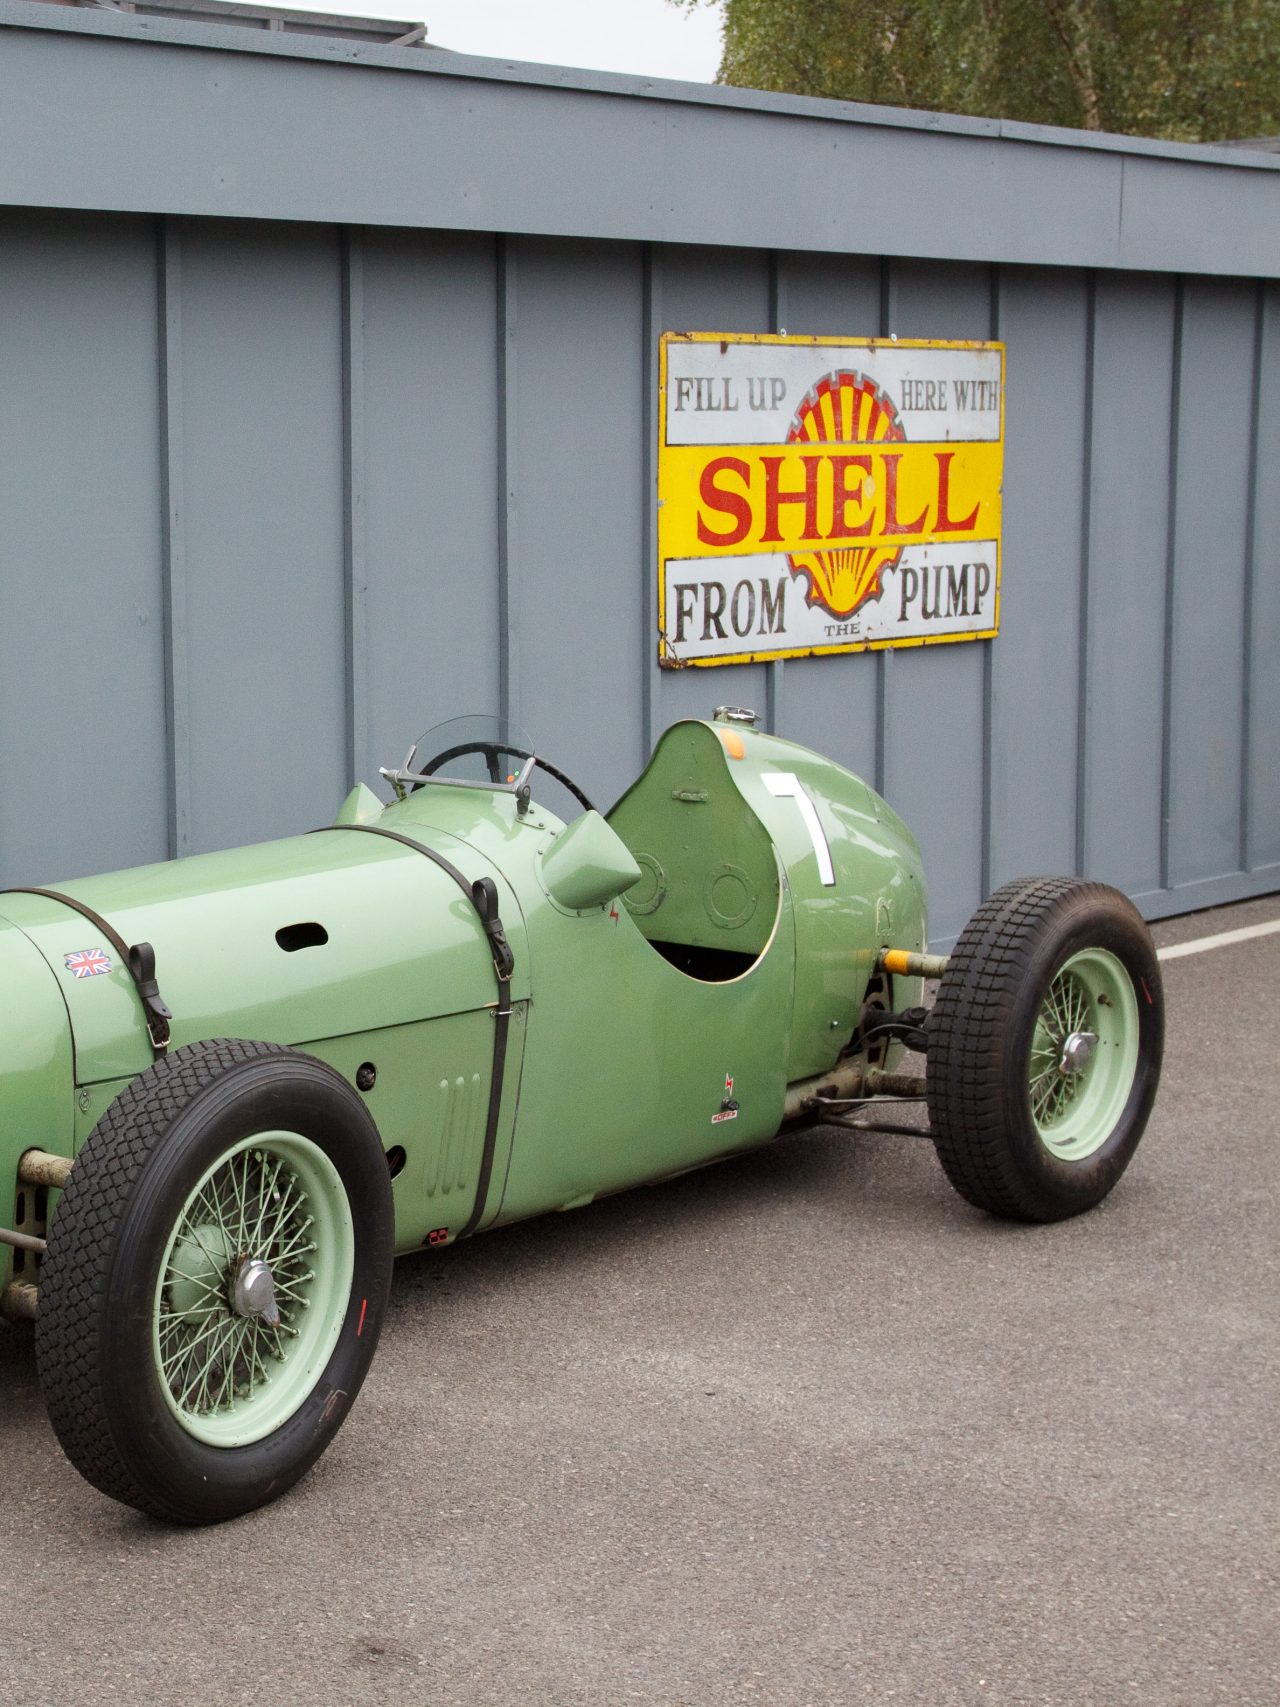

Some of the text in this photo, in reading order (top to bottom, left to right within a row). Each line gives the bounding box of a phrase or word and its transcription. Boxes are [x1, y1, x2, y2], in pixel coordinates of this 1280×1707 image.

[674, 376, 787, 412] FILL UP
[900, 378, 998, 412] HERE WITH
[696, 451, 981, 548] SHELL
[672, 562, 991, 644] FROM THE PUMP
[760, 772, 837, 887] 7
